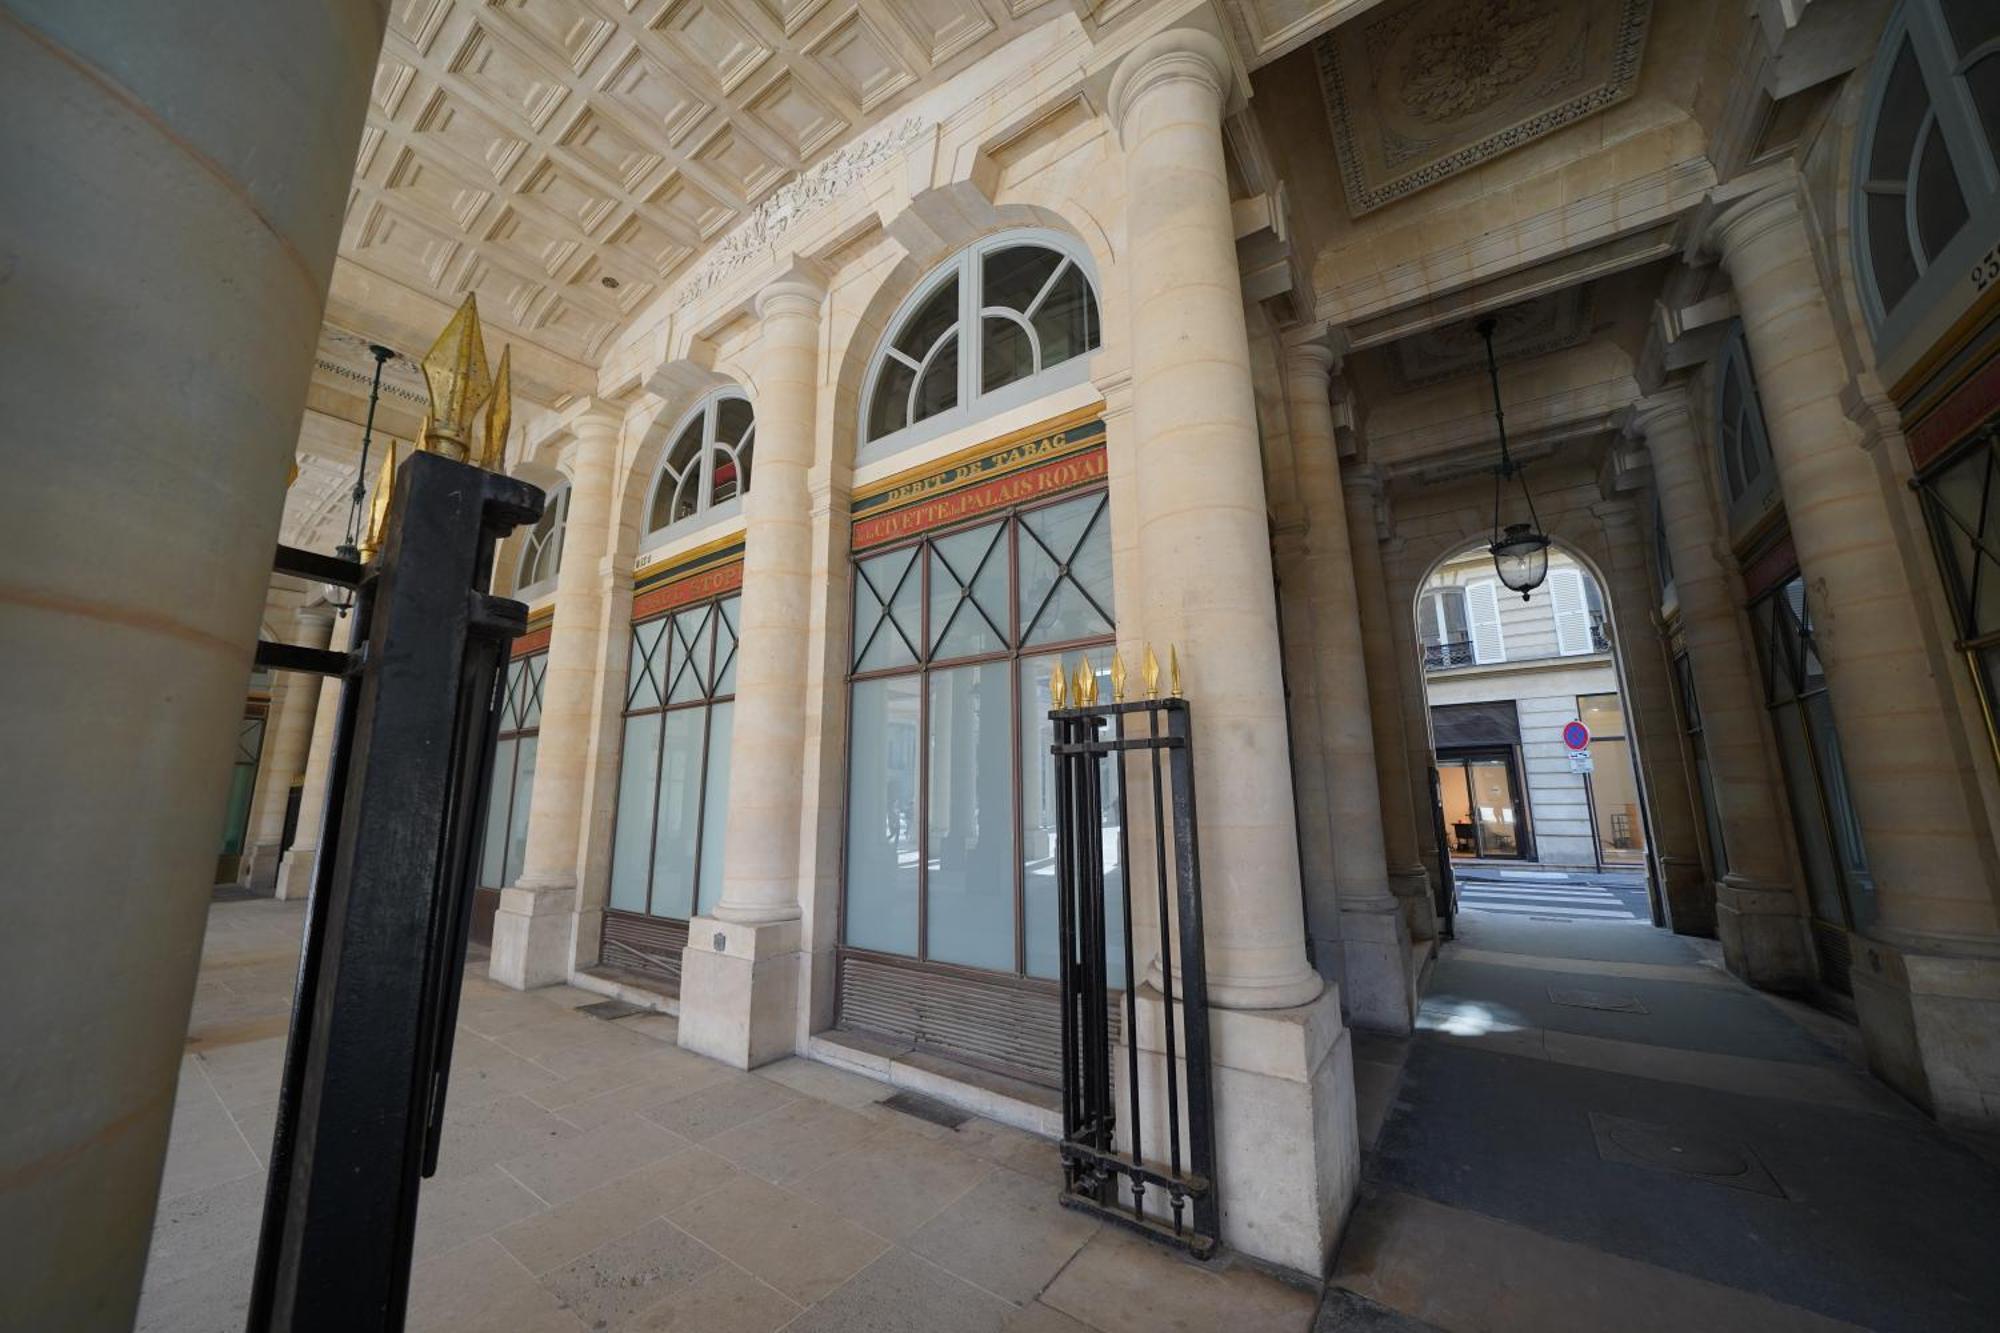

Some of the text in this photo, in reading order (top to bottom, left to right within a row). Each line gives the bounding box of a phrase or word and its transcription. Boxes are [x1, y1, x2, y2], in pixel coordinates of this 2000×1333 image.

[954, 461, 982, 481] DE
[992, 433, 1067, 467] TABAC
[875, 501, 949, 537] CIVETTE
[959, 477, 1034, 513] PALAIS
[1038, 454, 1106, 490] ROYAL
